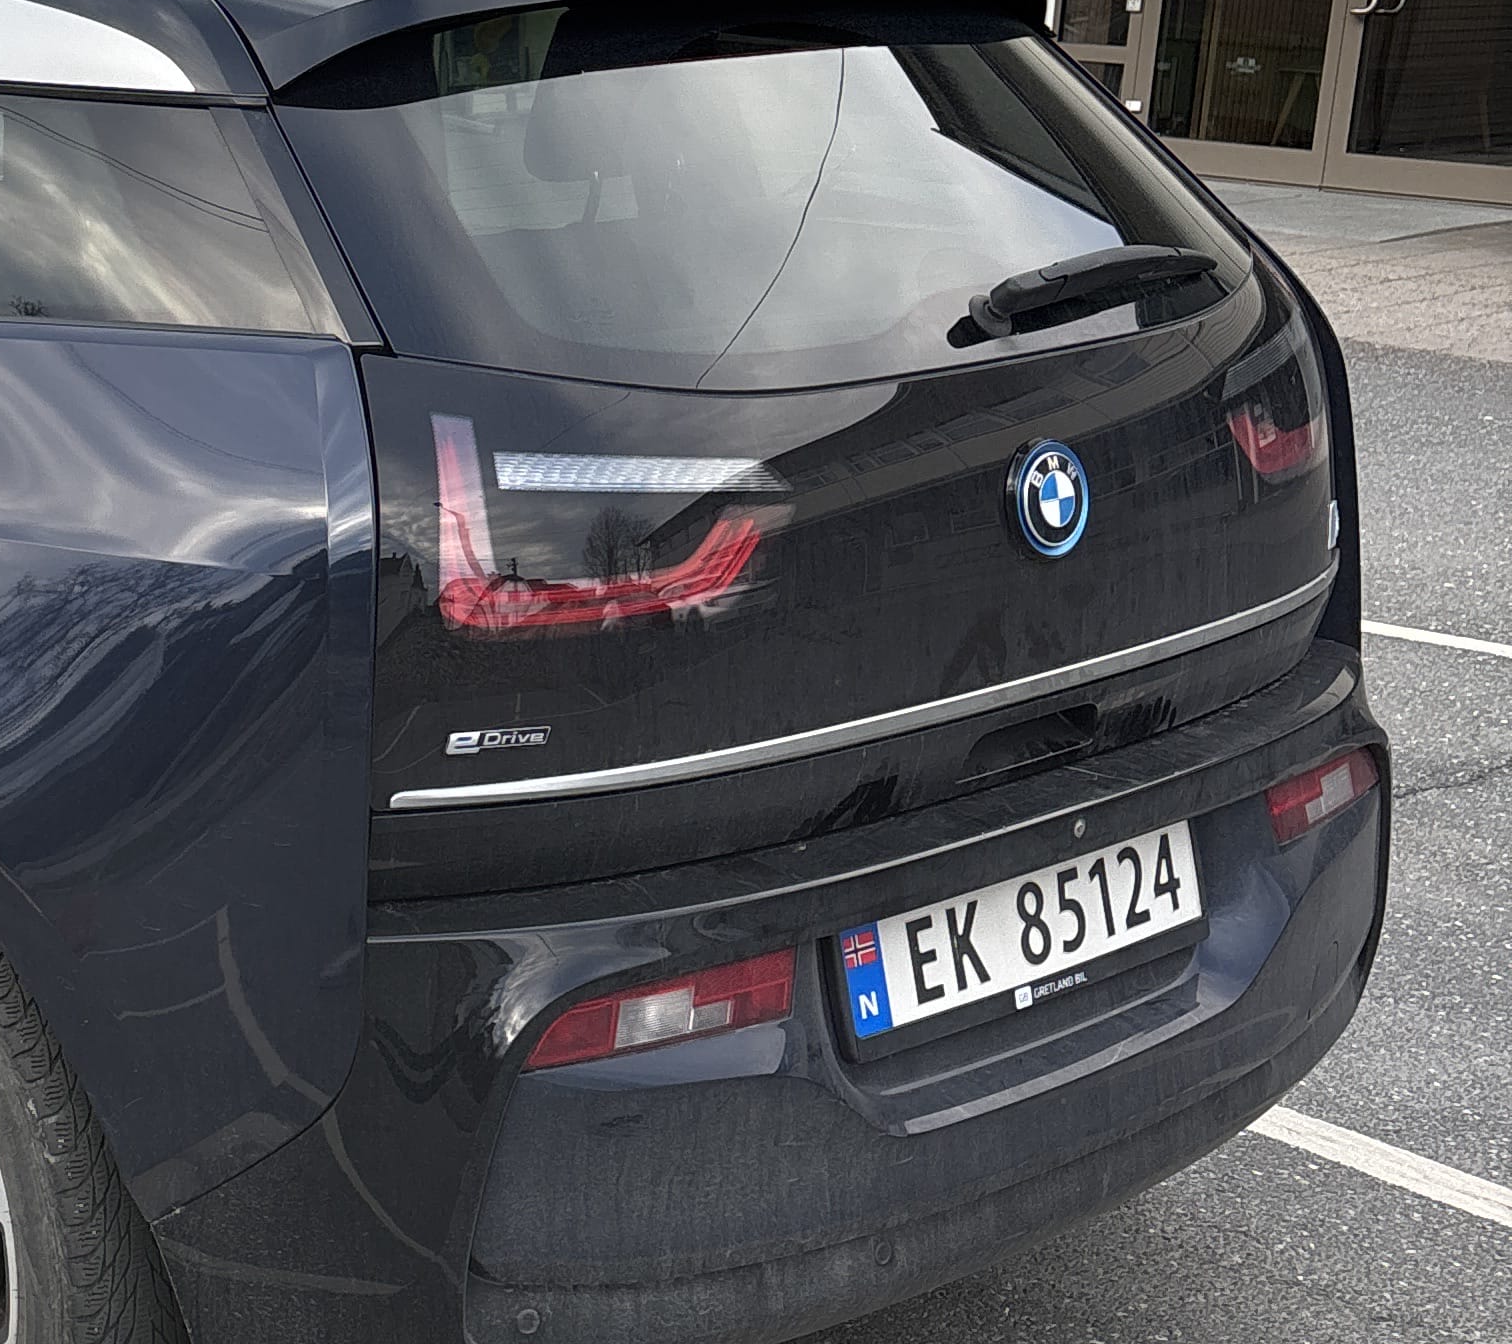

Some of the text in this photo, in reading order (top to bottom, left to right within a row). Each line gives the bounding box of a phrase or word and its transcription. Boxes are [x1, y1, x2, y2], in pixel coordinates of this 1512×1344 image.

[1030, 456, 1078, 488] BMW
[446, 730, 545, 755] eDrive
[905, 833, 1182, 1007] EK 85124
[1033, 975, 1075, 999] GRETLAND
[1074, 971, 1088, 985] BIL
[858, 991, 879, 1020] N
